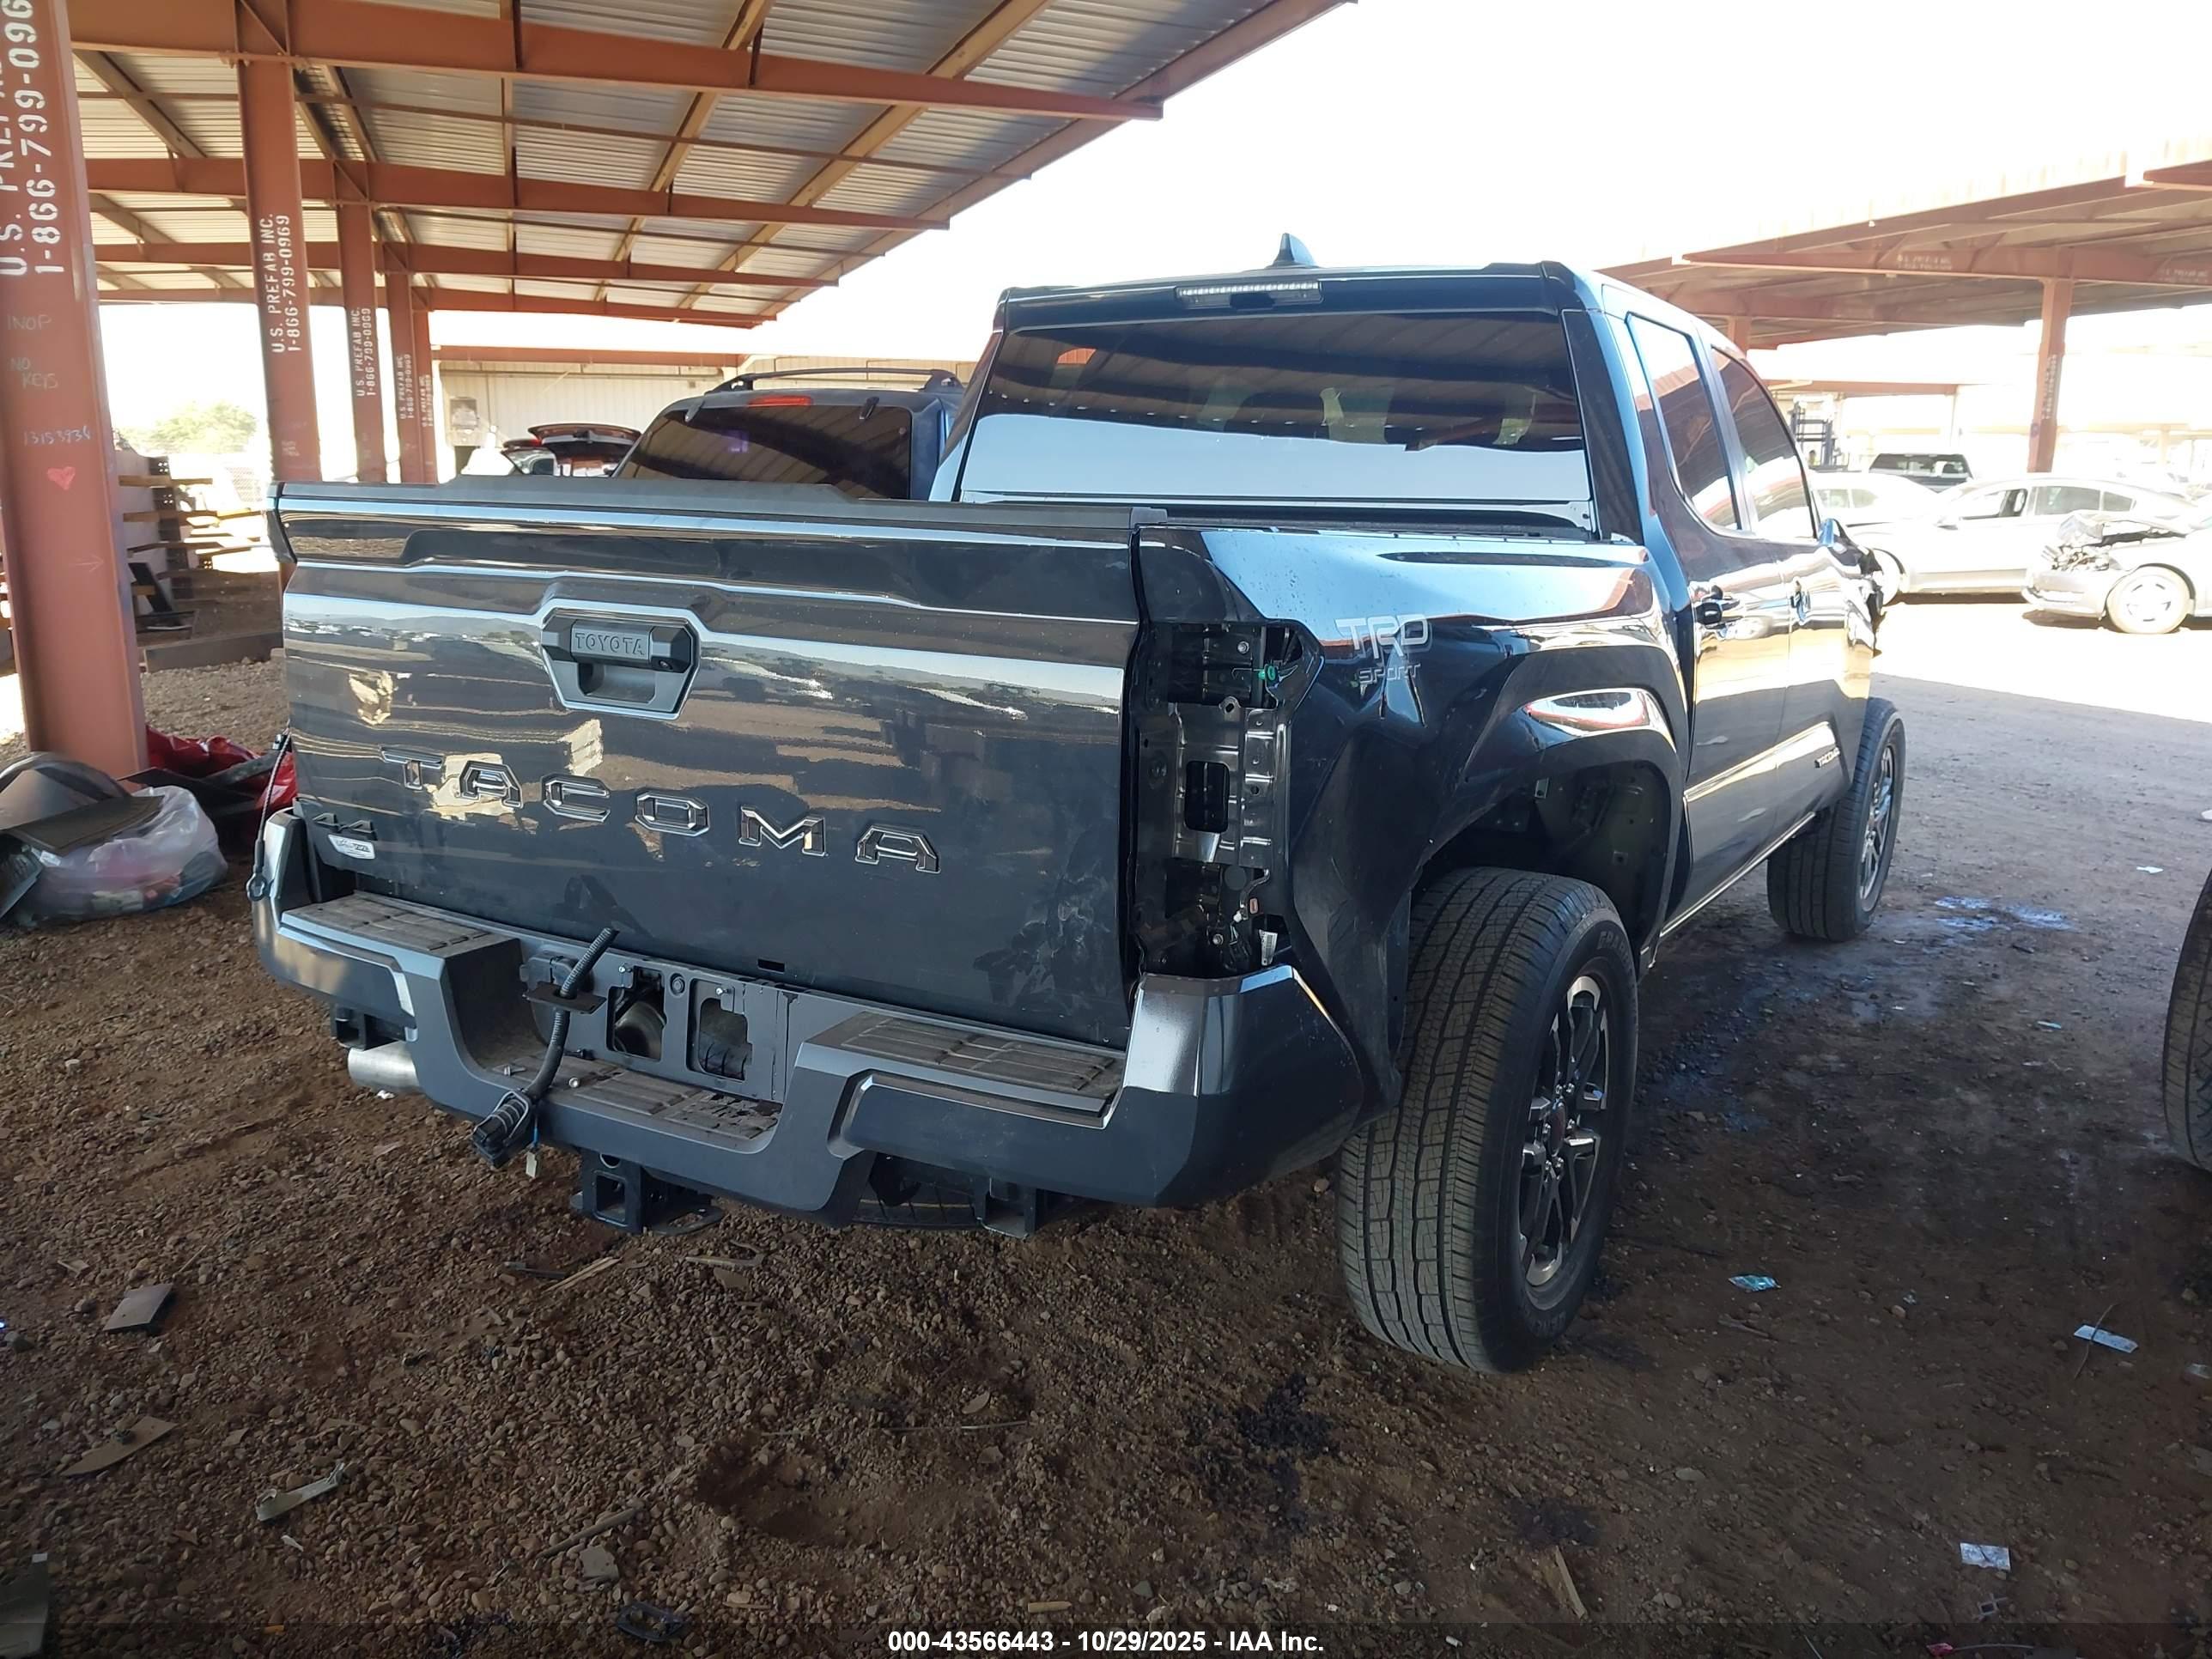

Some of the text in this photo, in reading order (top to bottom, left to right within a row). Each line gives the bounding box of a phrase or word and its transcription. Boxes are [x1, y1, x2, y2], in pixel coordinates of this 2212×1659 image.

[258, 214, 286, 353] U.S. PREFAB INC.
[275, 215, 301, 351] 1-866-799-0969
[7, 313, 53, 331] INOP
[351, 331, 364, 372] PREFAB
[574, 632, 645, 656] TOYOTA
[1335, 613, 1428, 659] TRD
[1358, 662, 1421, 684] SPORT
[380, 744, 940, 874] TACOMA
